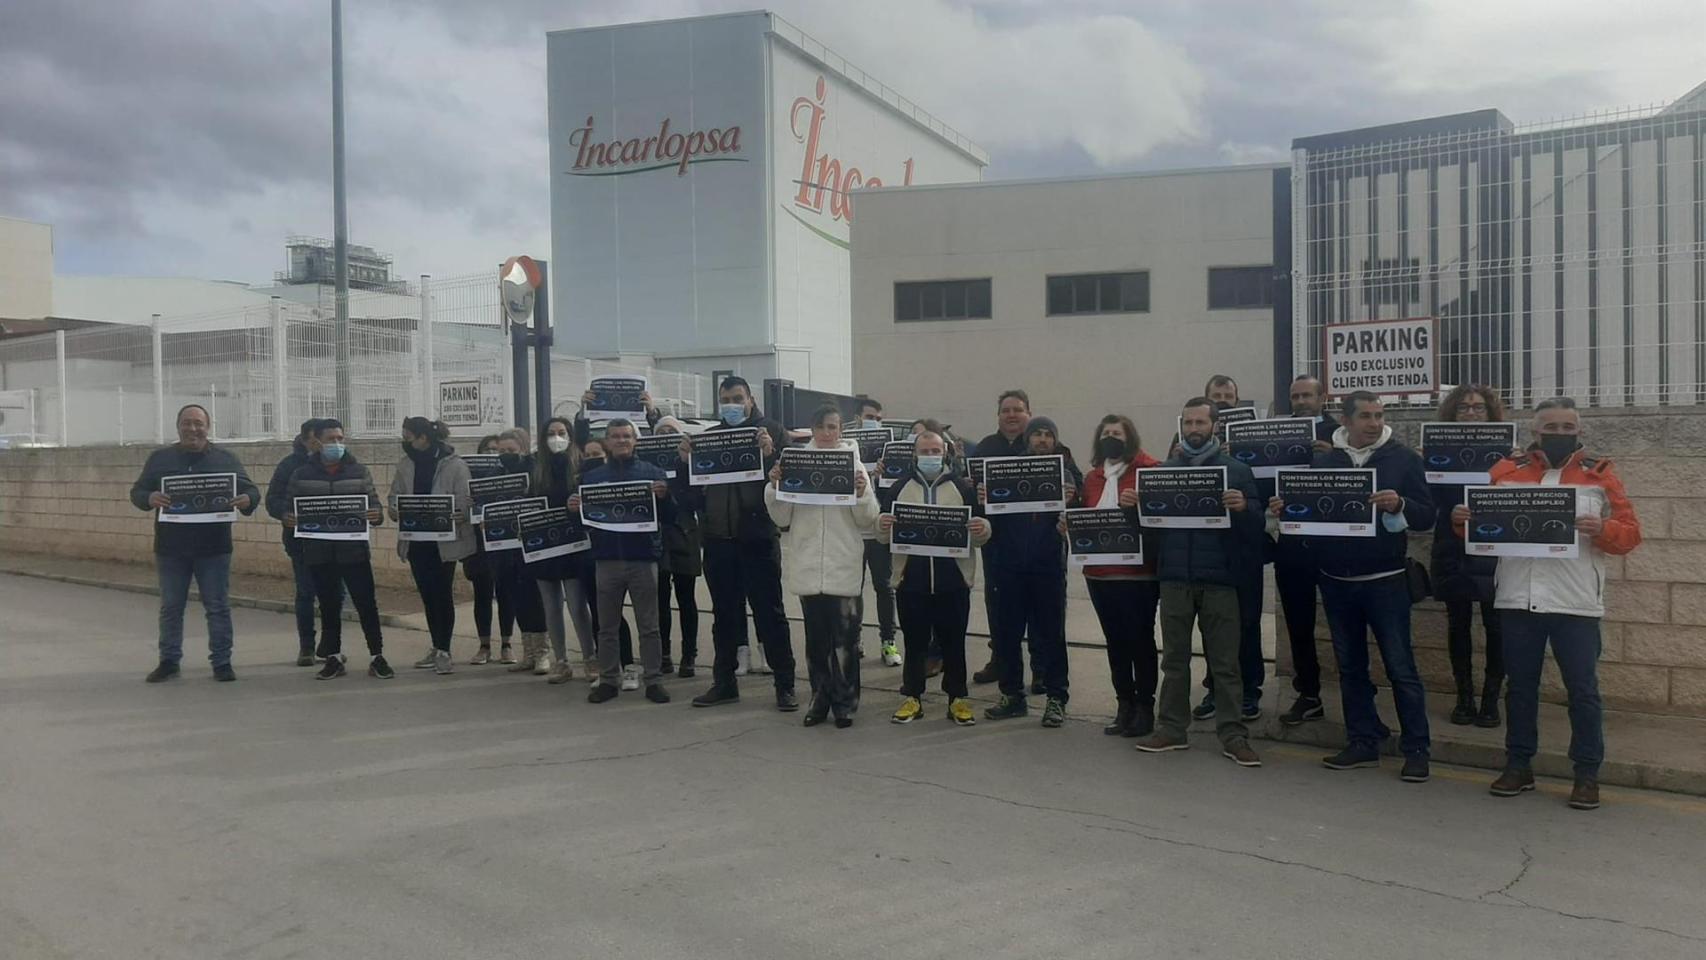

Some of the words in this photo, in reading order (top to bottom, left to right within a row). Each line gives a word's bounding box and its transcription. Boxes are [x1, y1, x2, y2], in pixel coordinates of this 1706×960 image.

[1332, 326, 1429, 355] PARKING
[1335, 360, 1358, 373] USO
[1361, 356, 1425, 372] EXCLUSIVO
[1332, 375, 1384, 389] CLIENTES
[1386, 373, 1429, 387] TIENDA
[442, 385, 478, 401] PARKING
